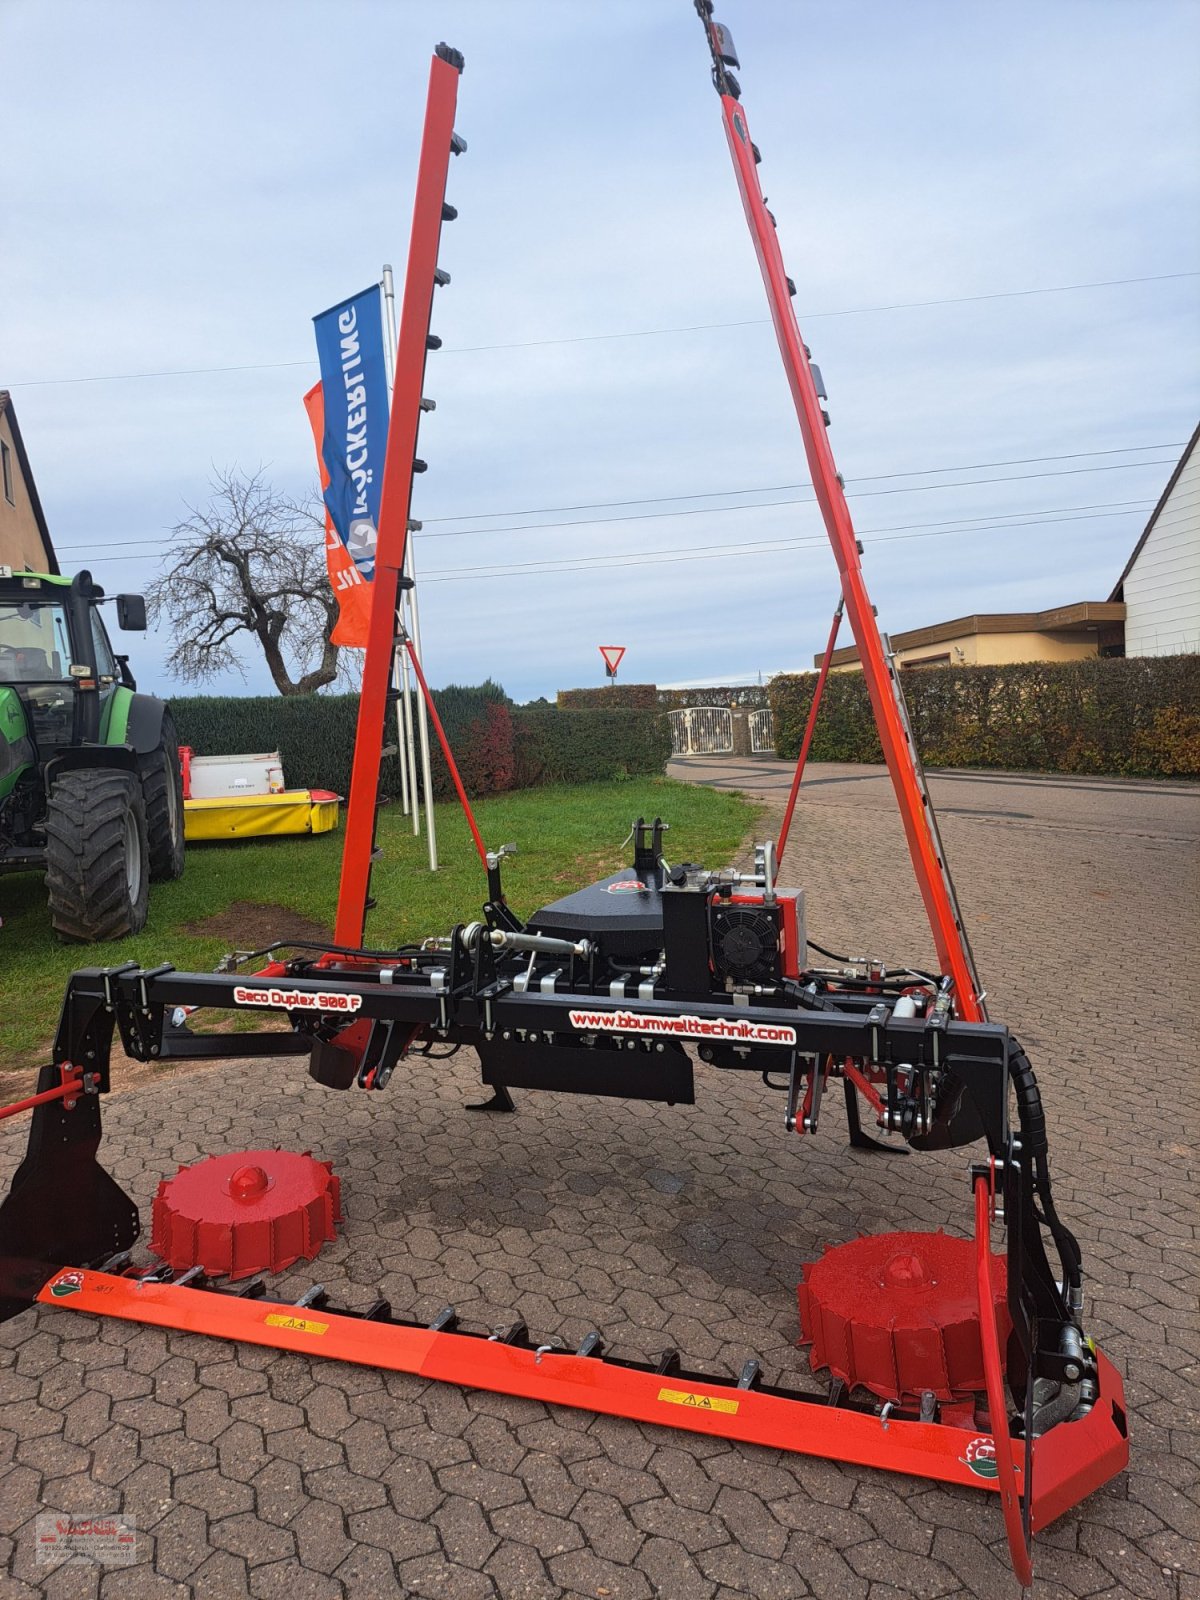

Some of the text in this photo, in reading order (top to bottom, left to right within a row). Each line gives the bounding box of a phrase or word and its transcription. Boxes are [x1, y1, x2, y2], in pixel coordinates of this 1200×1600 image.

[236, 990, 360, 1009] Seco Duplex 900 F
[572, 1012, 794, 1042] www.bbumwelttechnik.com
